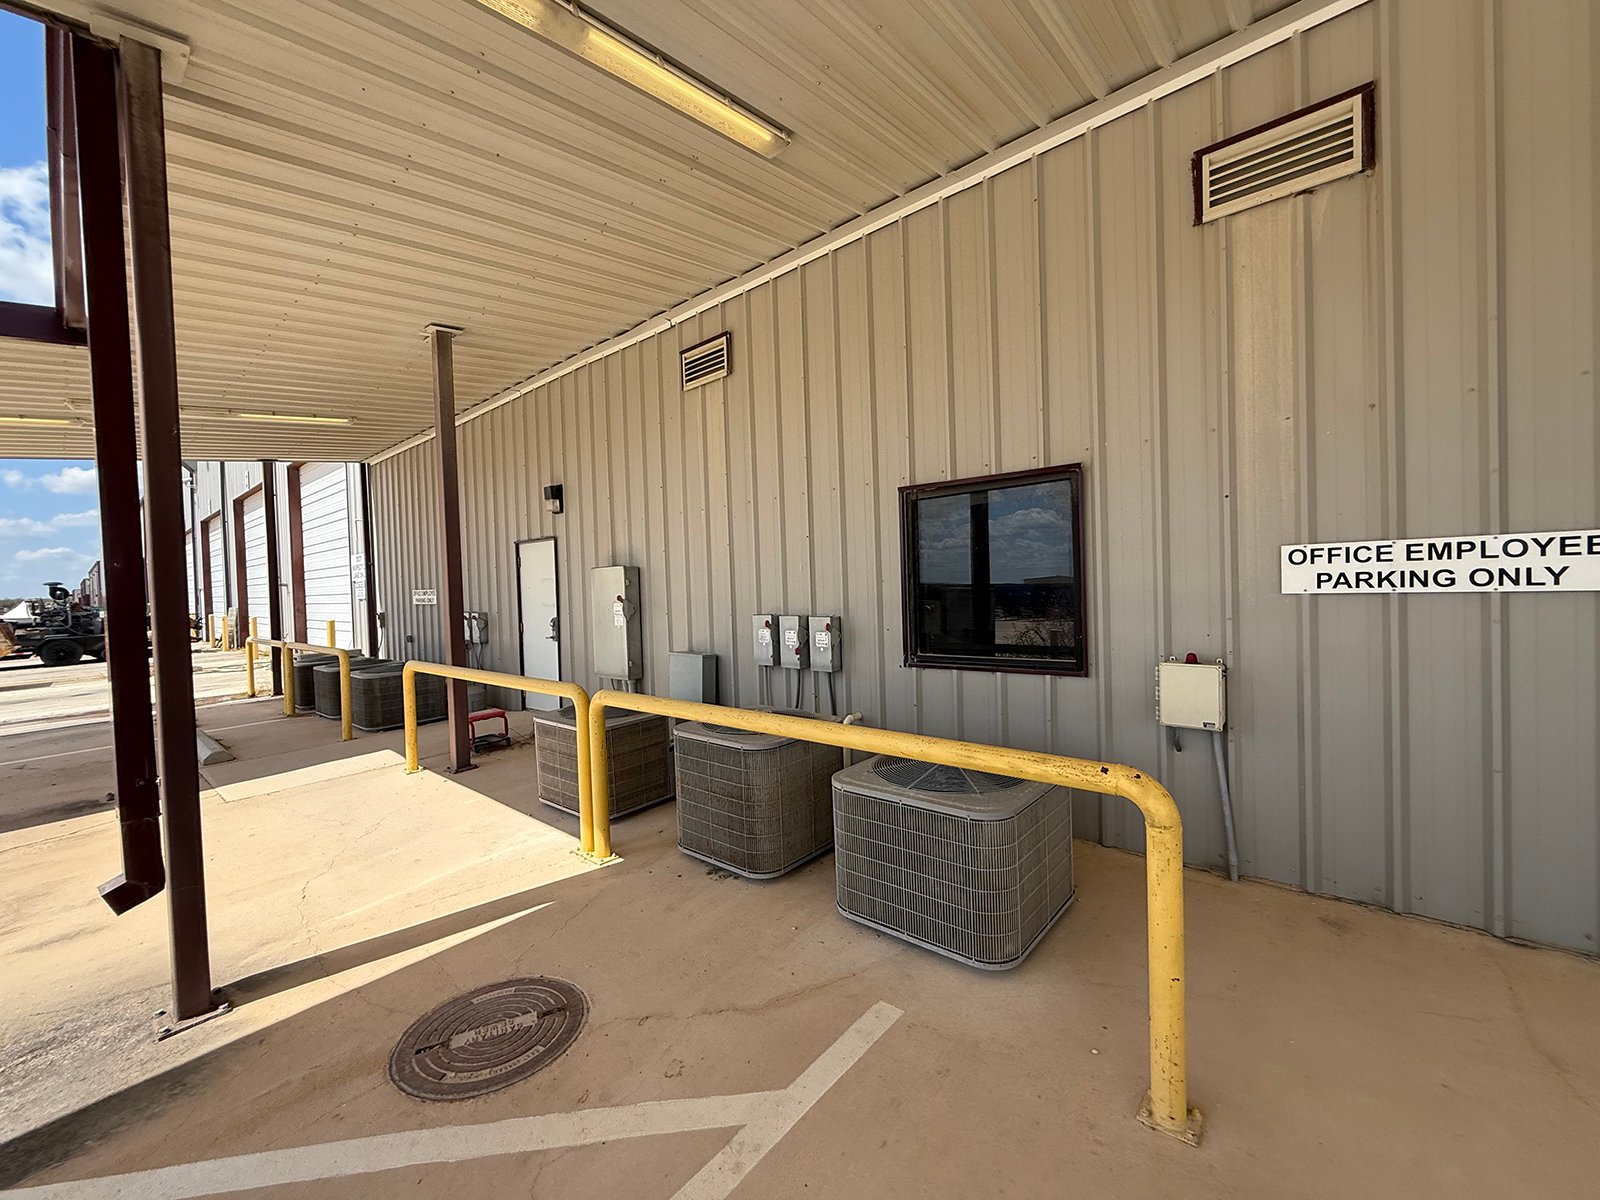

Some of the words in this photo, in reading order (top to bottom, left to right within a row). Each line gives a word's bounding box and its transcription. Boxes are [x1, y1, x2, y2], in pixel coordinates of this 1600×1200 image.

[1288, 544, 1394, 566] OFFICE
[1406, 534, 1600, 562] EMPLOYEE
[1316, 568, 1456, 590] PARKING
[1468, 565, 1570, 588] ONLY
